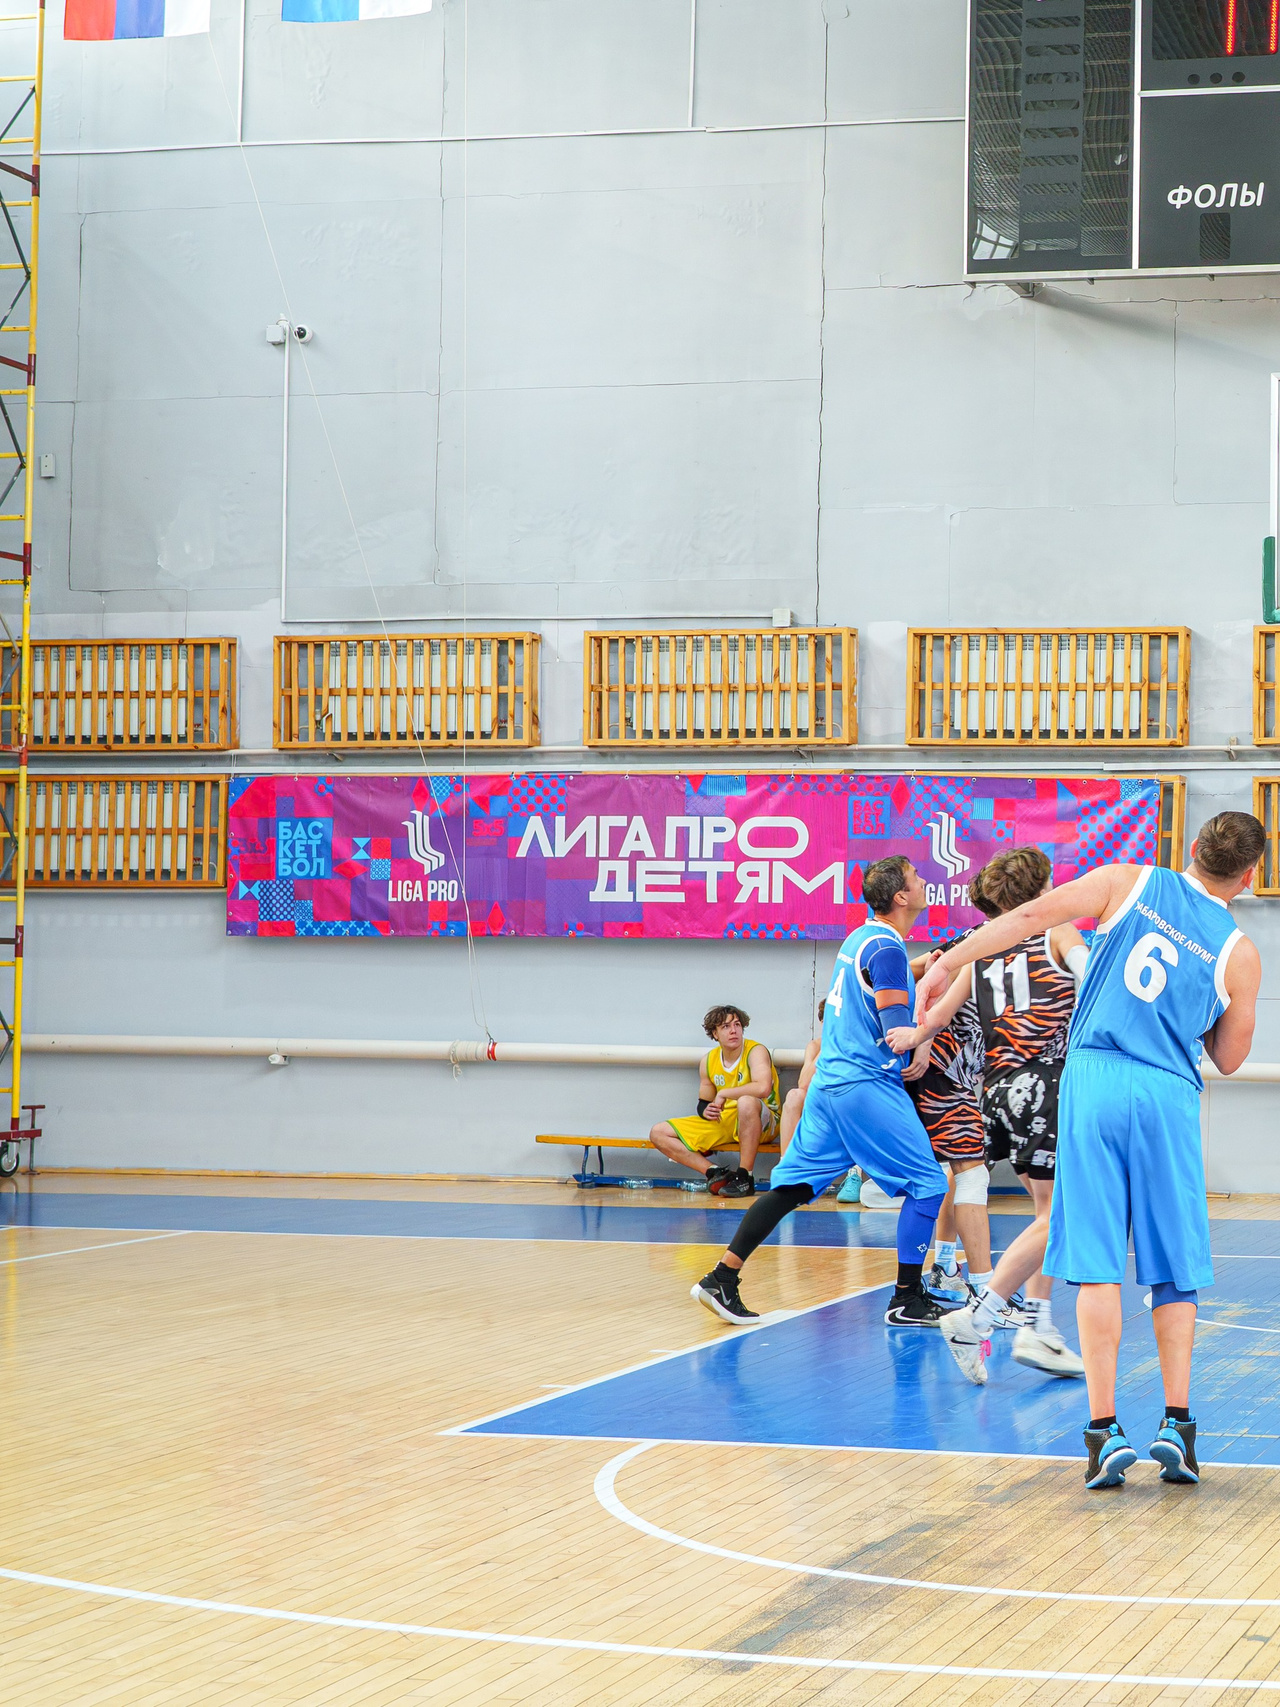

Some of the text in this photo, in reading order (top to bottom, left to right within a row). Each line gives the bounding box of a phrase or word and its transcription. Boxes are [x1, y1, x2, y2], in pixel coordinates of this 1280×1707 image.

[1167, 182, 1265, 209] ФОЛЫ
[279, 821, 324, 839] БАС
[279, 840, 321, 858] КЕТ
[278, 858, 325, 876] БОЛ
[388, 880, 458, 901] LIGA PRO
[589, 860, 844, 904] ДЕТЯМ
[950, 884, 973, 907] PR
[1124, 931, 1179, 1003] 6
[826, 967, 844, 1017] 4
[982, 952, 1030, 1017] 11
